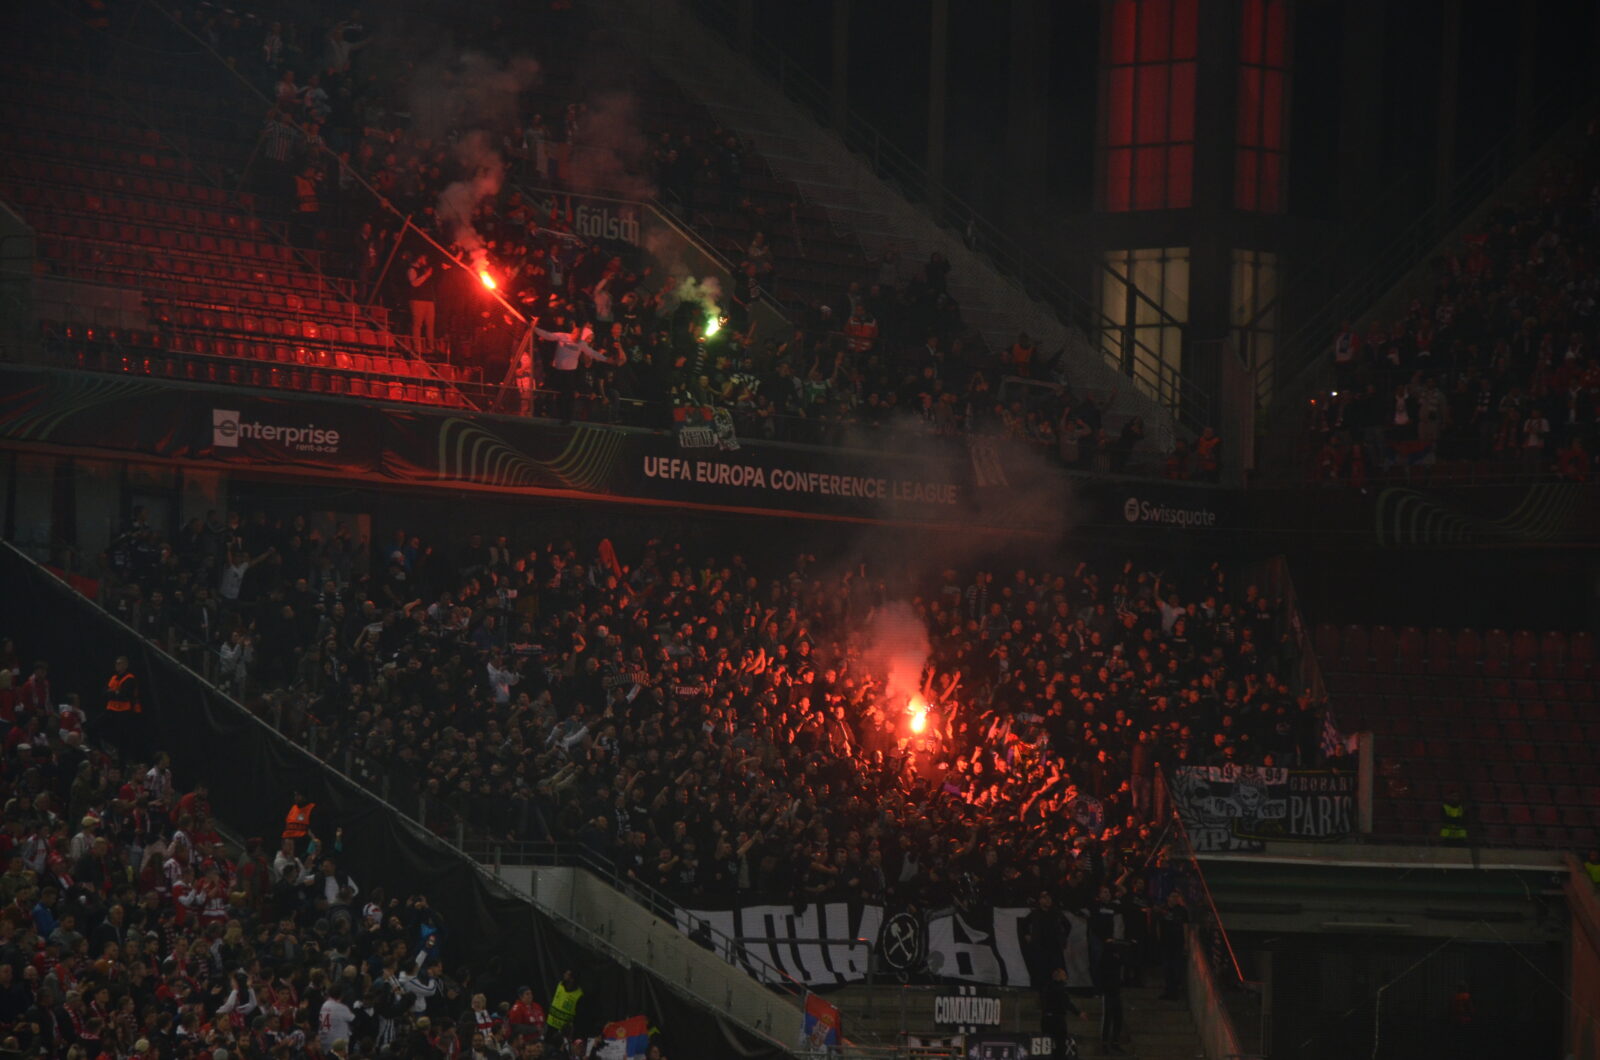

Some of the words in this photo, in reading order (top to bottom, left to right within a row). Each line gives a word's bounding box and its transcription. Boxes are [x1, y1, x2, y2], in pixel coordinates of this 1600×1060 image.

[219, 420, 340, 447] enterprise
[296, 443, 338, 453] rent-a-car
[643, 456, 692, 480] UEFA
[696, 461, 766, 488] EUROPA
[770, 468, 887, 499] CONFERENCE
[892, 479, 957, 504] LEAGUE
[1140, 500, 1217, 528] Swissquote
[1289, 794, 1354, 837] PARIS
[935, 996, 1001, 1025] COMMANDO
